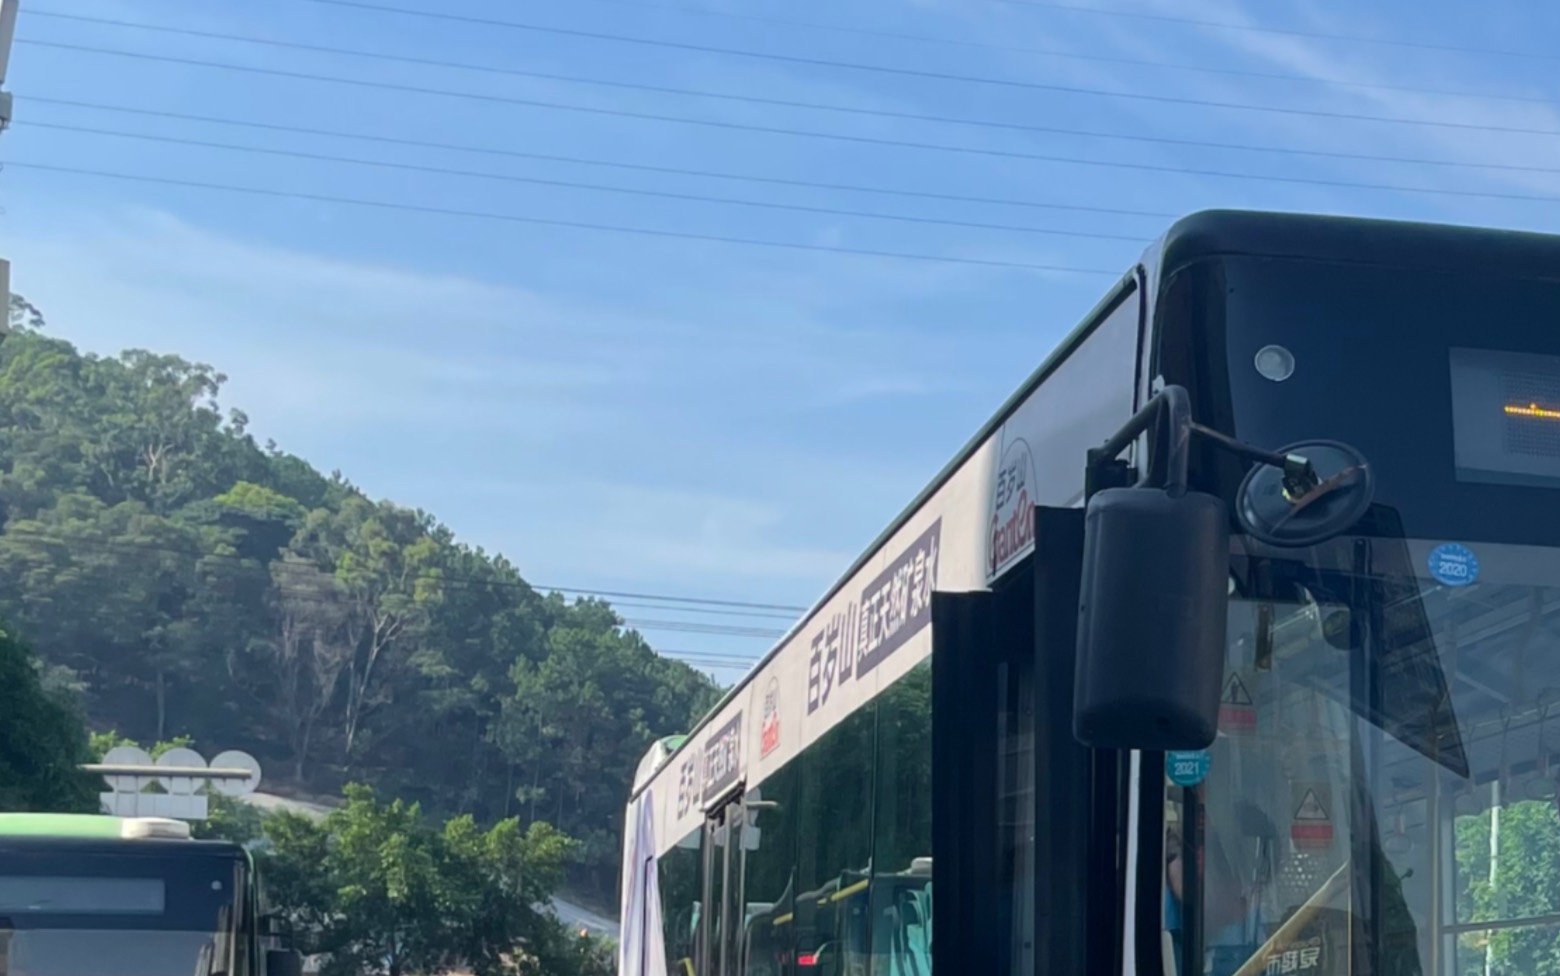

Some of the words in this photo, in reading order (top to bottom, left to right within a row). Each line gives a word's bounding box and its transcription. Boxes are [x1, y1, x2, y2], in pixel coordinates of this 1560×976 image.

[1439, 561, 1467, 577] 2020
[807, 600, 857, 716] 百岁山
[1174, 760, 1200, 776] 2021
